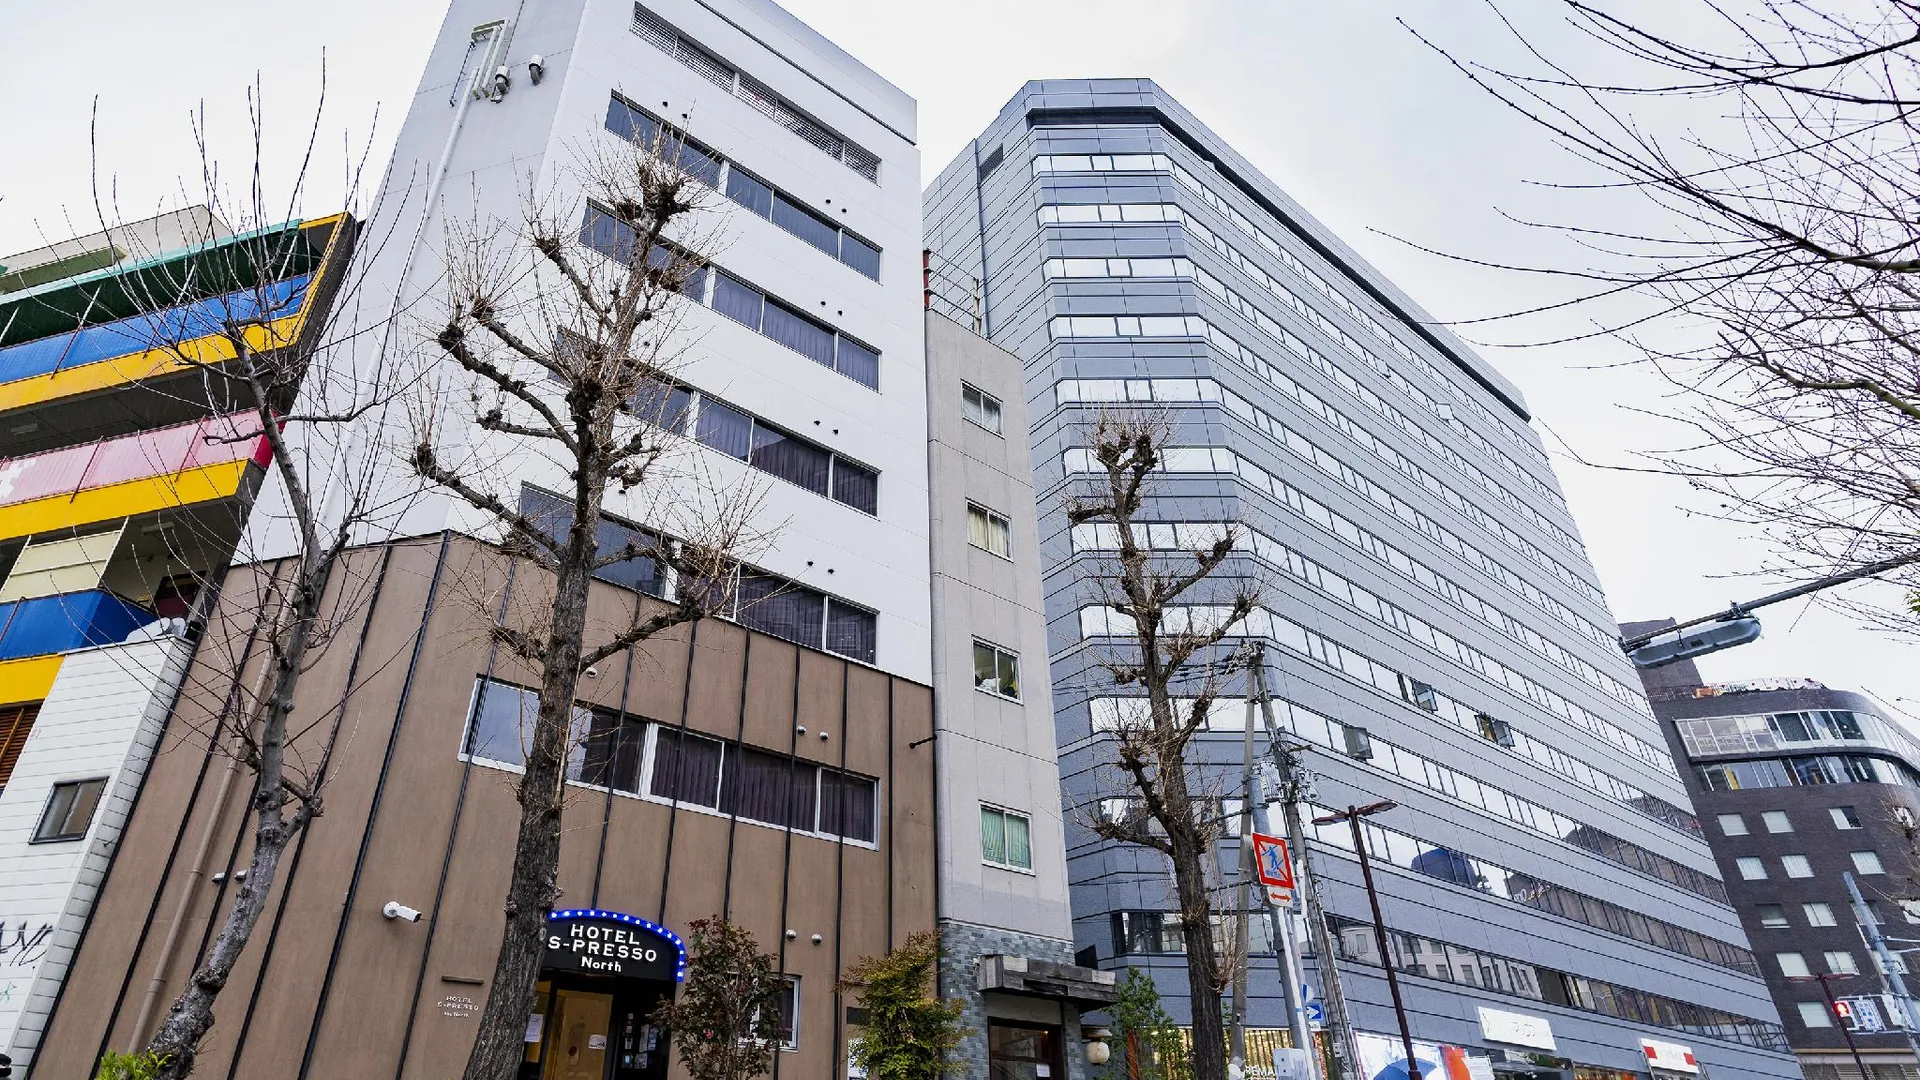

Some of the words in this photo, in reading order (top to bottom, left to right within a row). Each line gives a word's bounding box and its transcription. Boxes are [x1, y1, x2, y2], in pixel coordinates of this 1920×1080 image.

[570, 923, 640, 946] HOTEL
[548, 935, 657, 962] S-PRESSO
[580, 956, 622, 972] North
[445, 995, 473, 1004] HOTEL
